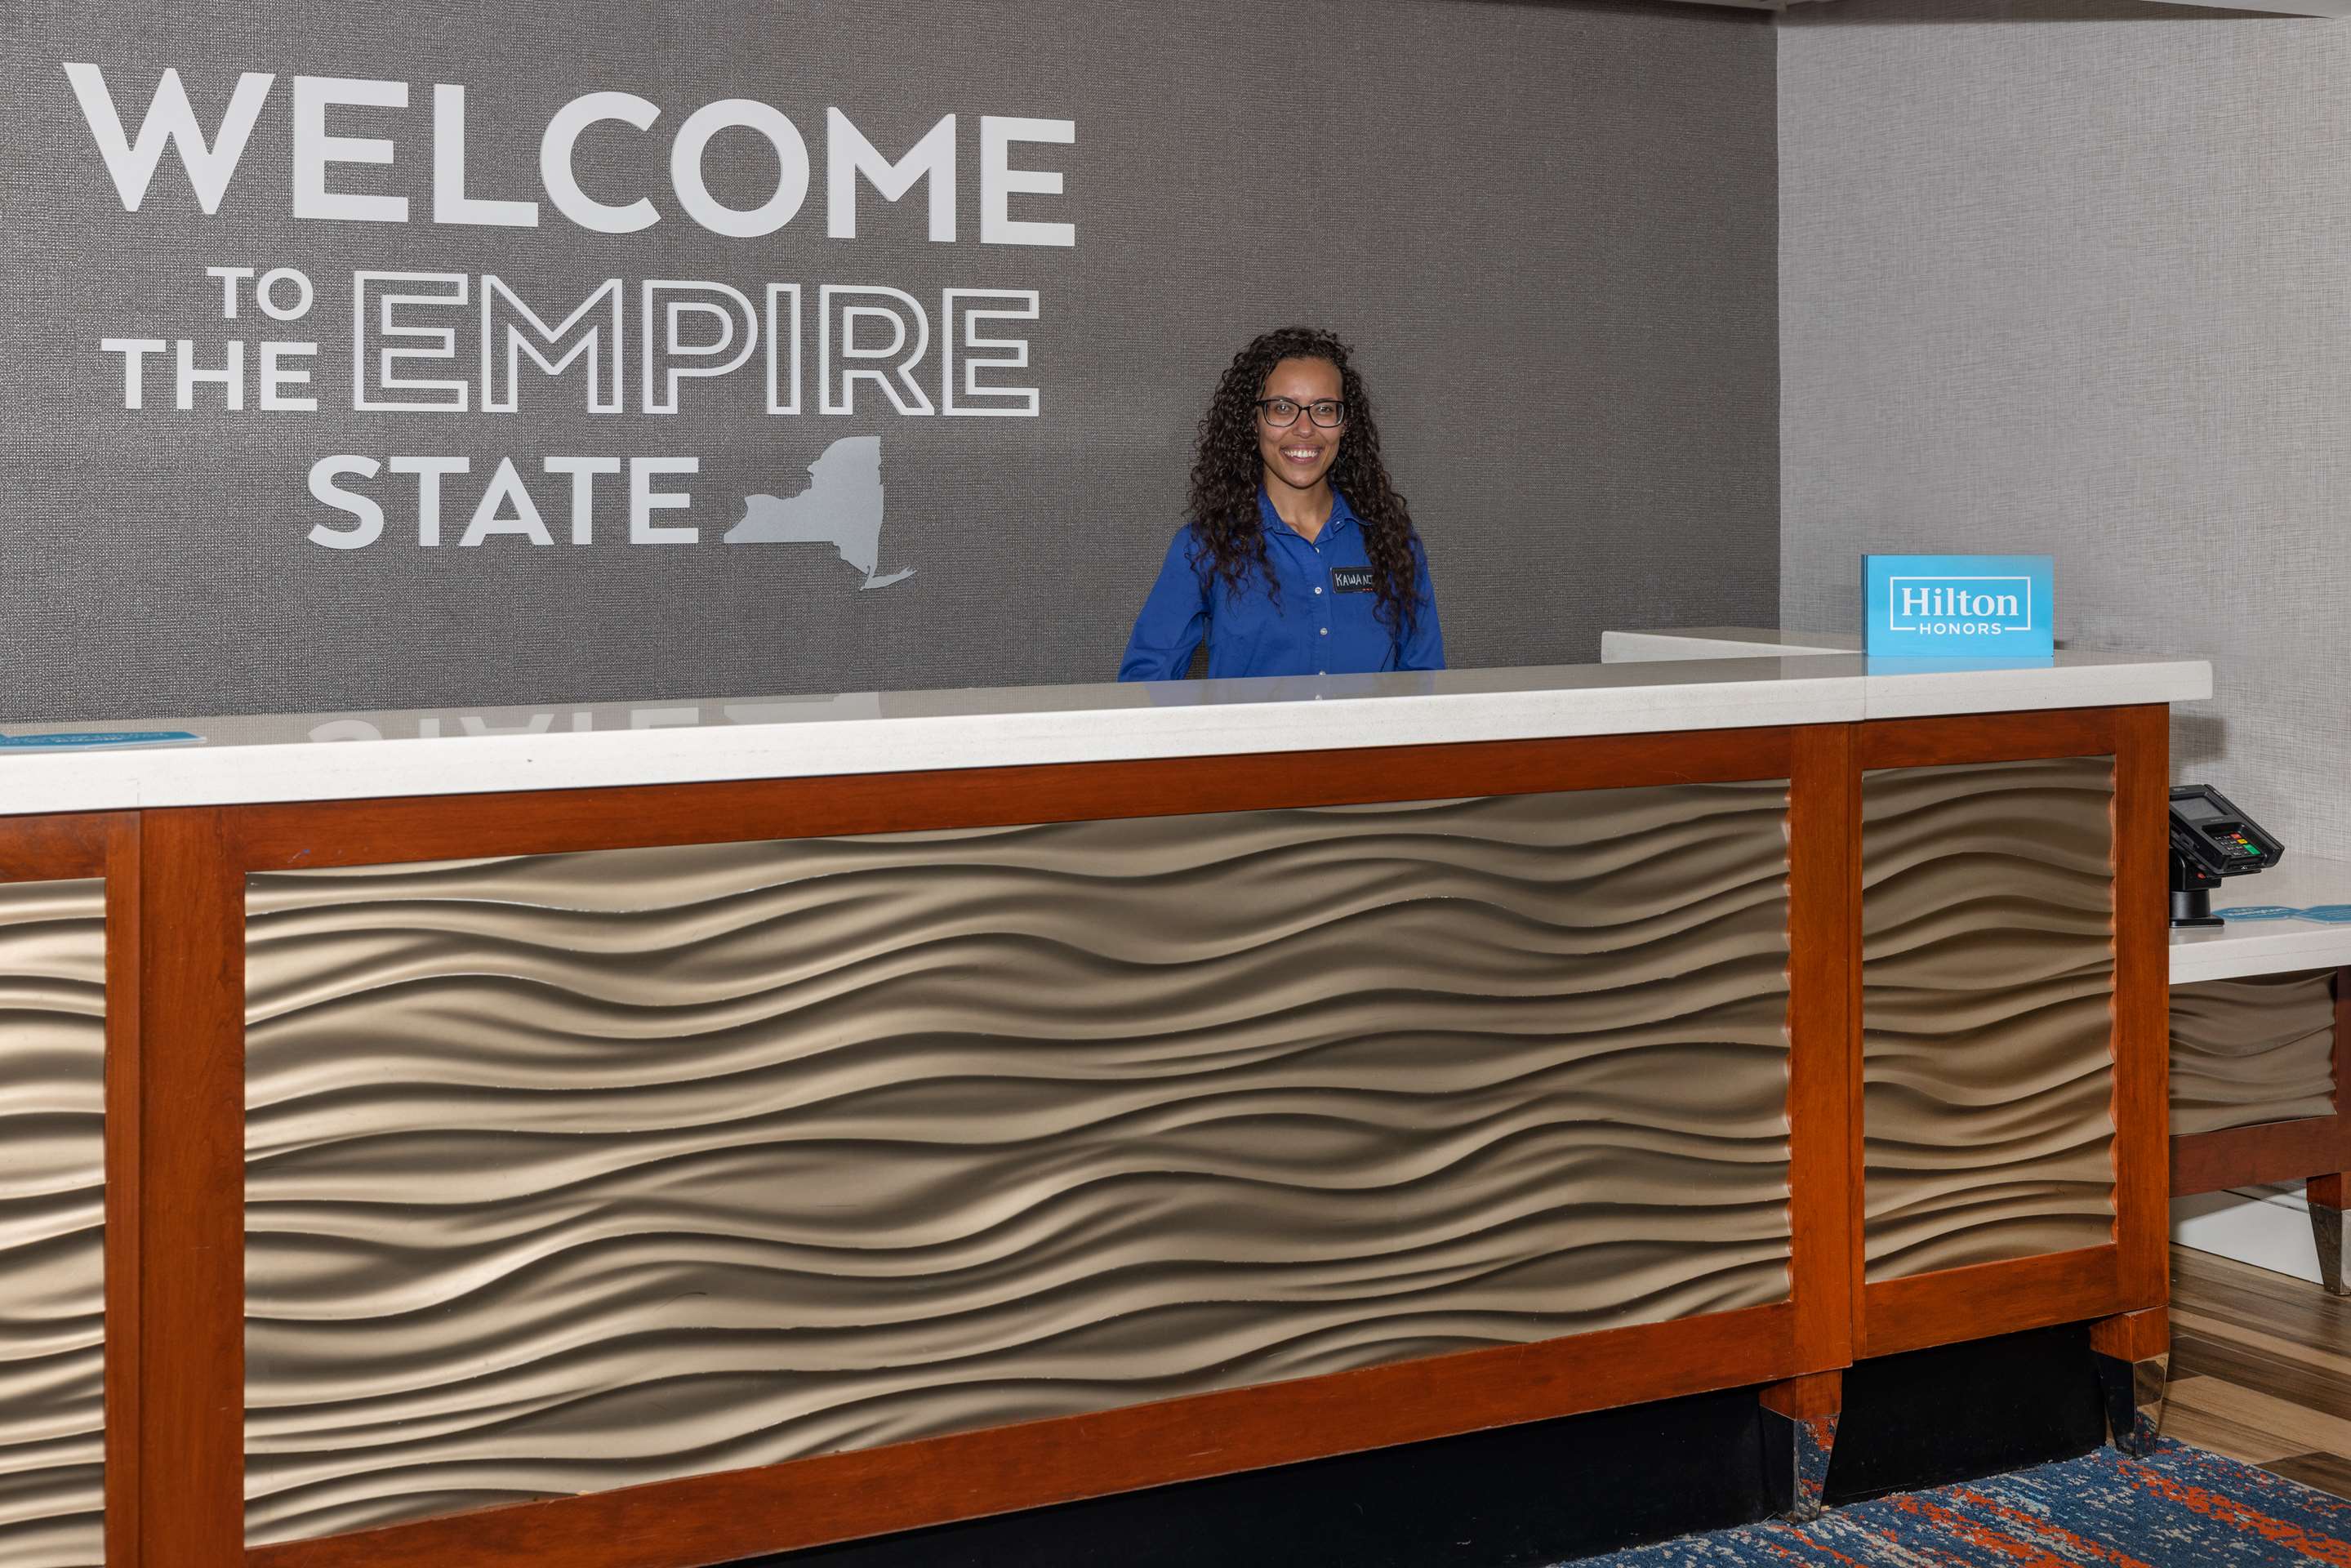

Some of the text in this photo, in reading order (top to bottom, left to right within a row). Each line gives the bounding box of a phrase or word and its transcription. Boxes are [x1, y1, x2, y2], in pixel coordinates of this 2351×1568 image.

[63, 62, 1075, 247] WELCOME
[207, 266, 314, 321] TO
[100, 270, 1040, 416] THE EMPIRE
[307, 454, 699, 550] STATE
[1901, 587, 2019, 617] Hilton
[1919, 622, 2001, 635] HONORS
